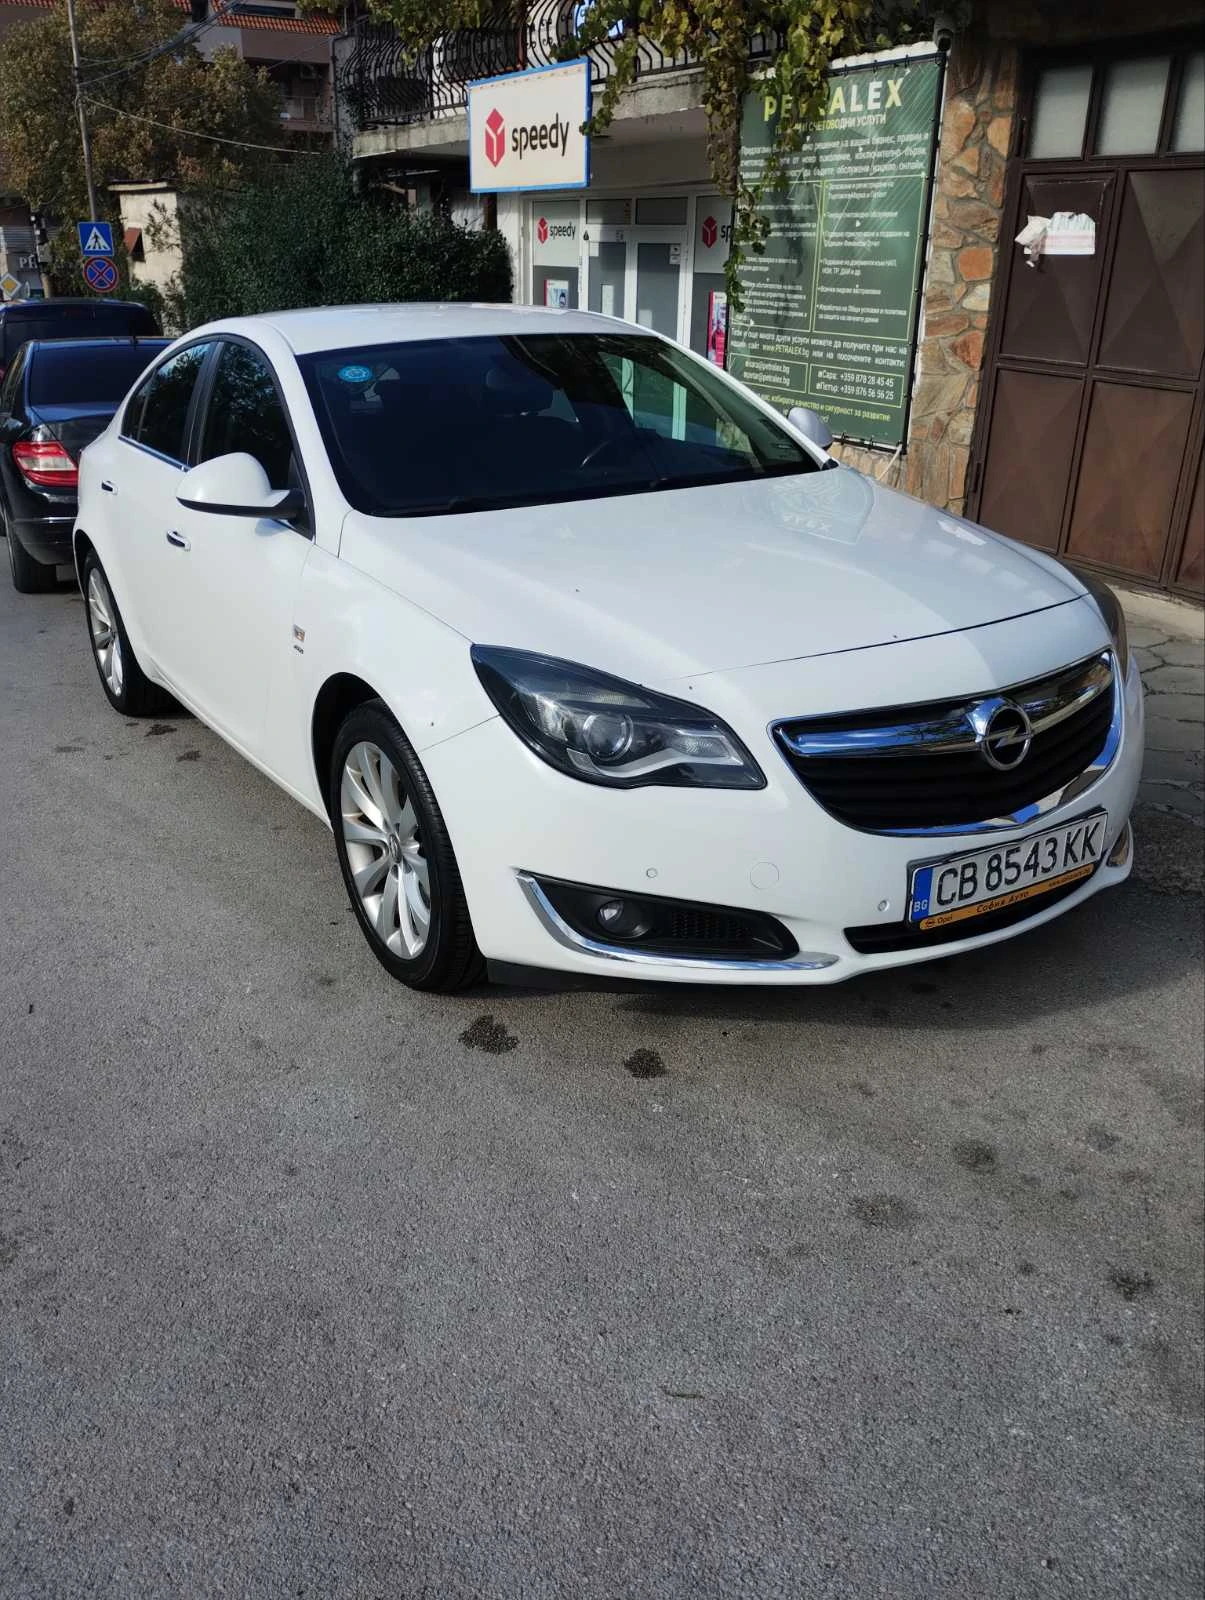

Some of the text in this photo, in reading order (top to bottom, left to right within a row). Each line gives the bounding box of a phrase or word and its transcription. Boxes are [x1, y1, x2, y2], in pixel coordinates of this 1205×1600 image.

[764, 79, 903, 121] PEALEX
[856, 113, 887, 126] УСЛУГИ
[511, 113, 570, 159] speedy
[549, 220, 576, 241] speedy
[833, 340, 841, 349] да
[842, 341, 871, 352] получите
[872, 344, 884, 355] при
[885, 345, 896, 354] нас
[840, 373, 855, 384] +359
[868, 376, 876, 386] 28
[876, 377, 885, 387] 45
[885, 378, 894, 389] 45
[840, 384, 855, 395] +359
[885, 390, 894, 401] 25
[936, 821, 1100, 906] CB 8543 KK
[913, 899, 928, 913] BG
[976, 899, 1005, 913] София
[937, 914, 953, 925] Opel
